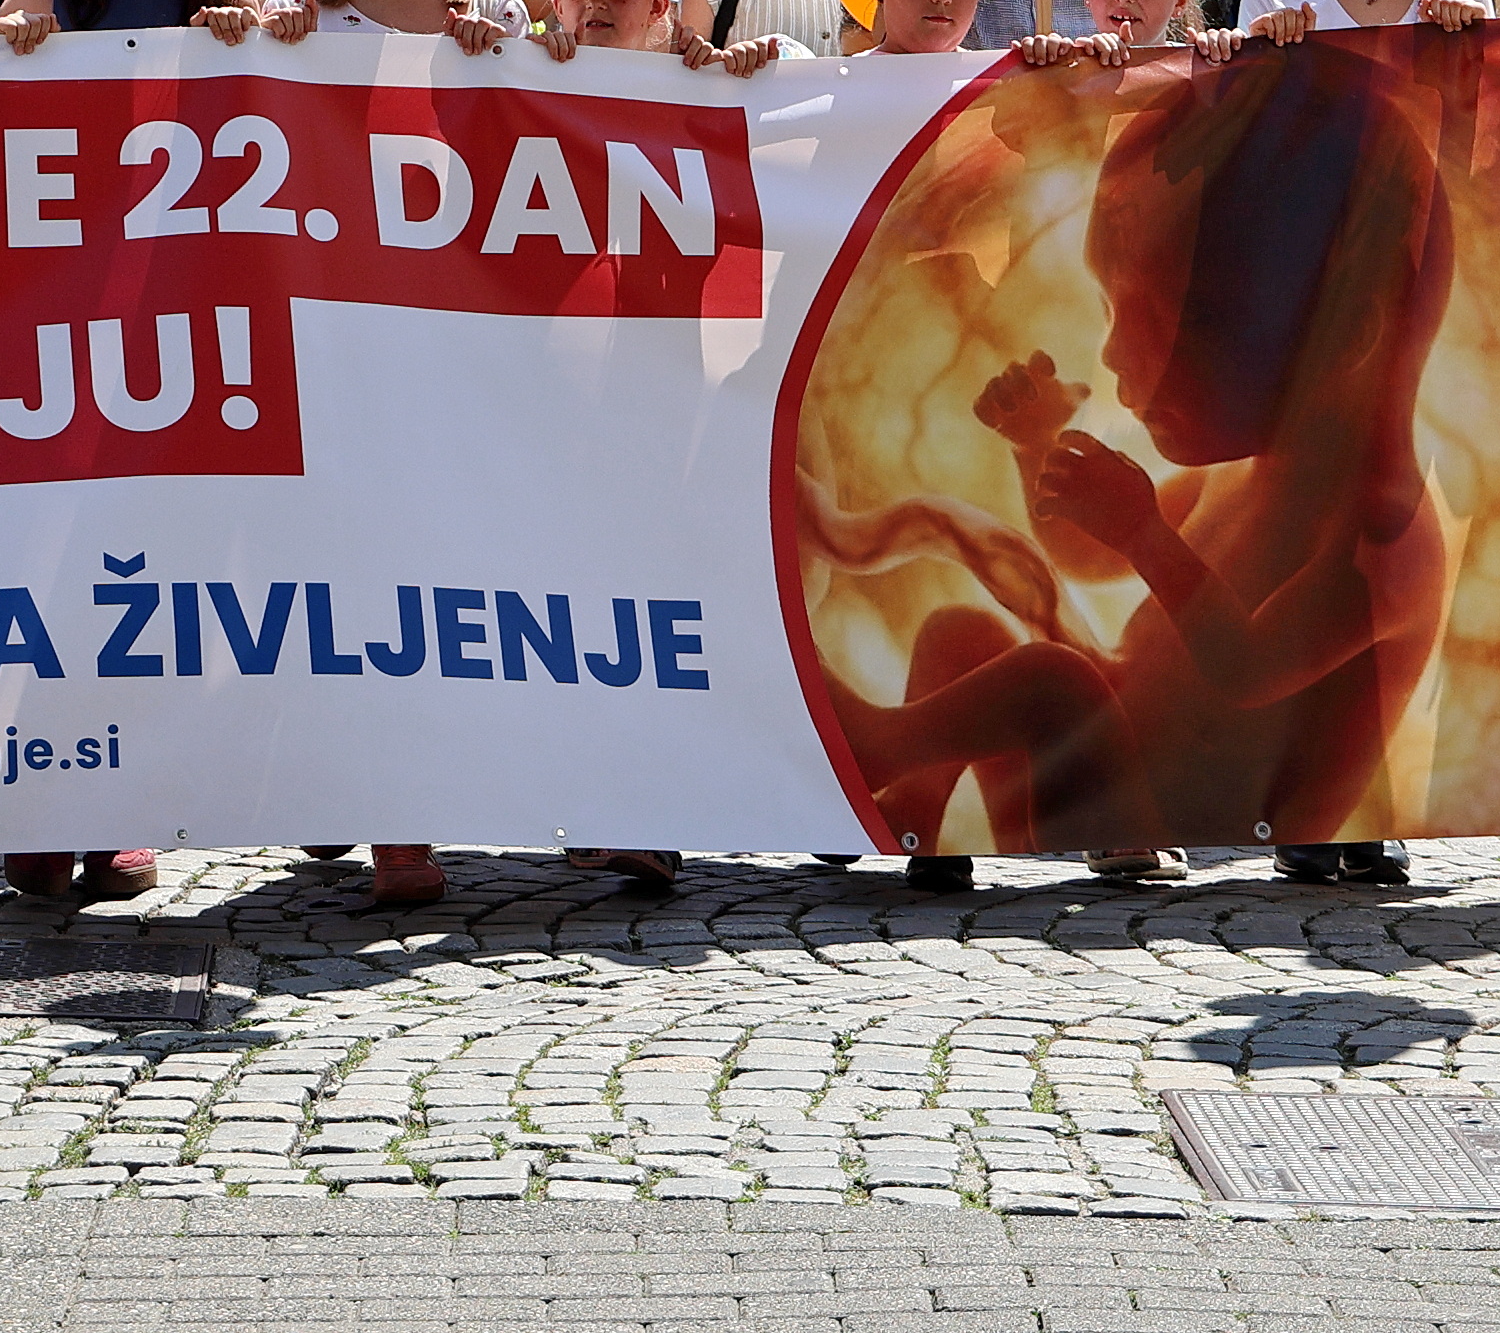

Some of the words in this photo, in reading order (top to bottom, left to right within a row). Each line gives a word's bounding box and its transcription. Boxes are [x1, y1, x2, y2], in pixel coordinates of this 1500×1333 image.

[119, 114, 340, 243] 22.
[370, 134, 717, 256] DAN
[92, 550, 710, 691] ŽIVLJENJE
